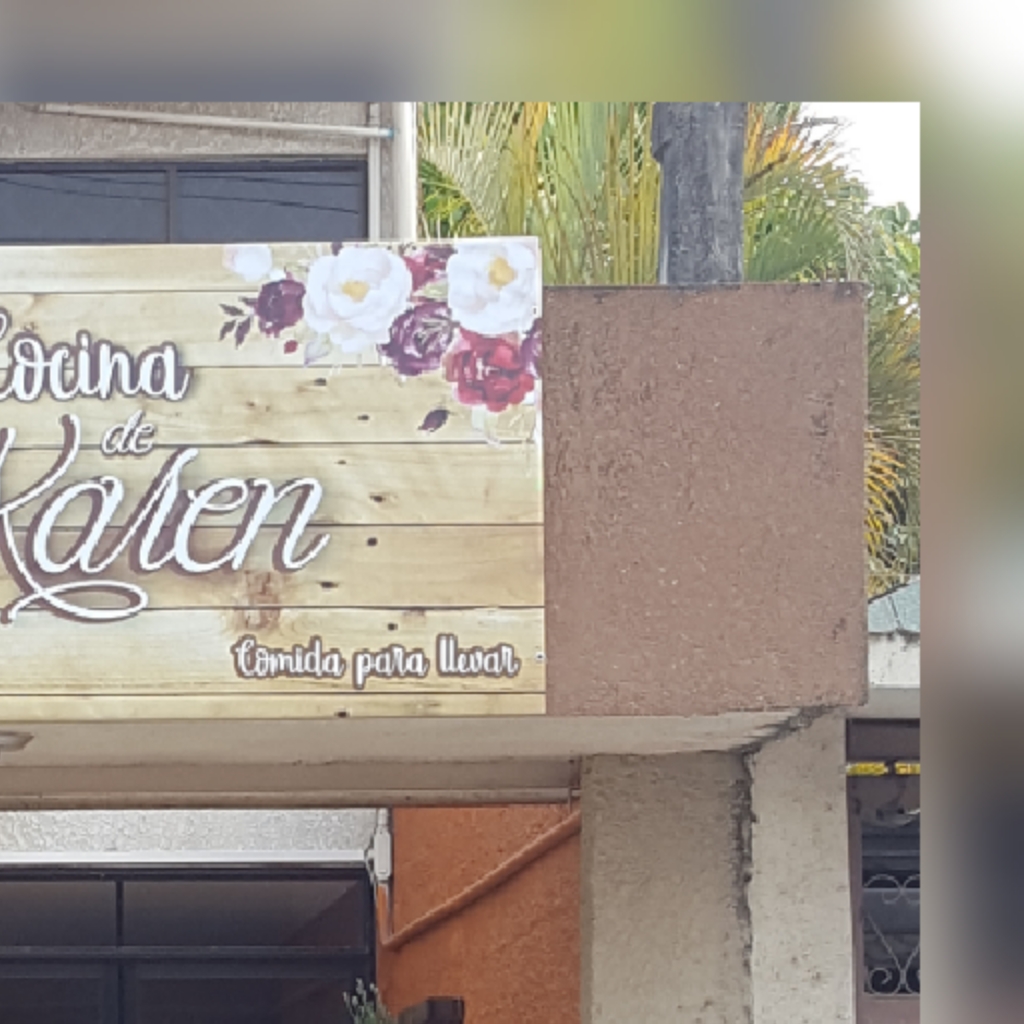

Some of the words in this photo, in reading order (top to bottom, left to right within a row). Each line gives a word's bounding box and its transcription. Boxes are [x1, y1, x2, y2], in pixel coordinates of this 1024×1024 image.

[100, 409, 154, 455] de
[232, 636, 344, 679] Comida
[352, 644, 429, 689] para
[437, 634, 520, 678] llevar
